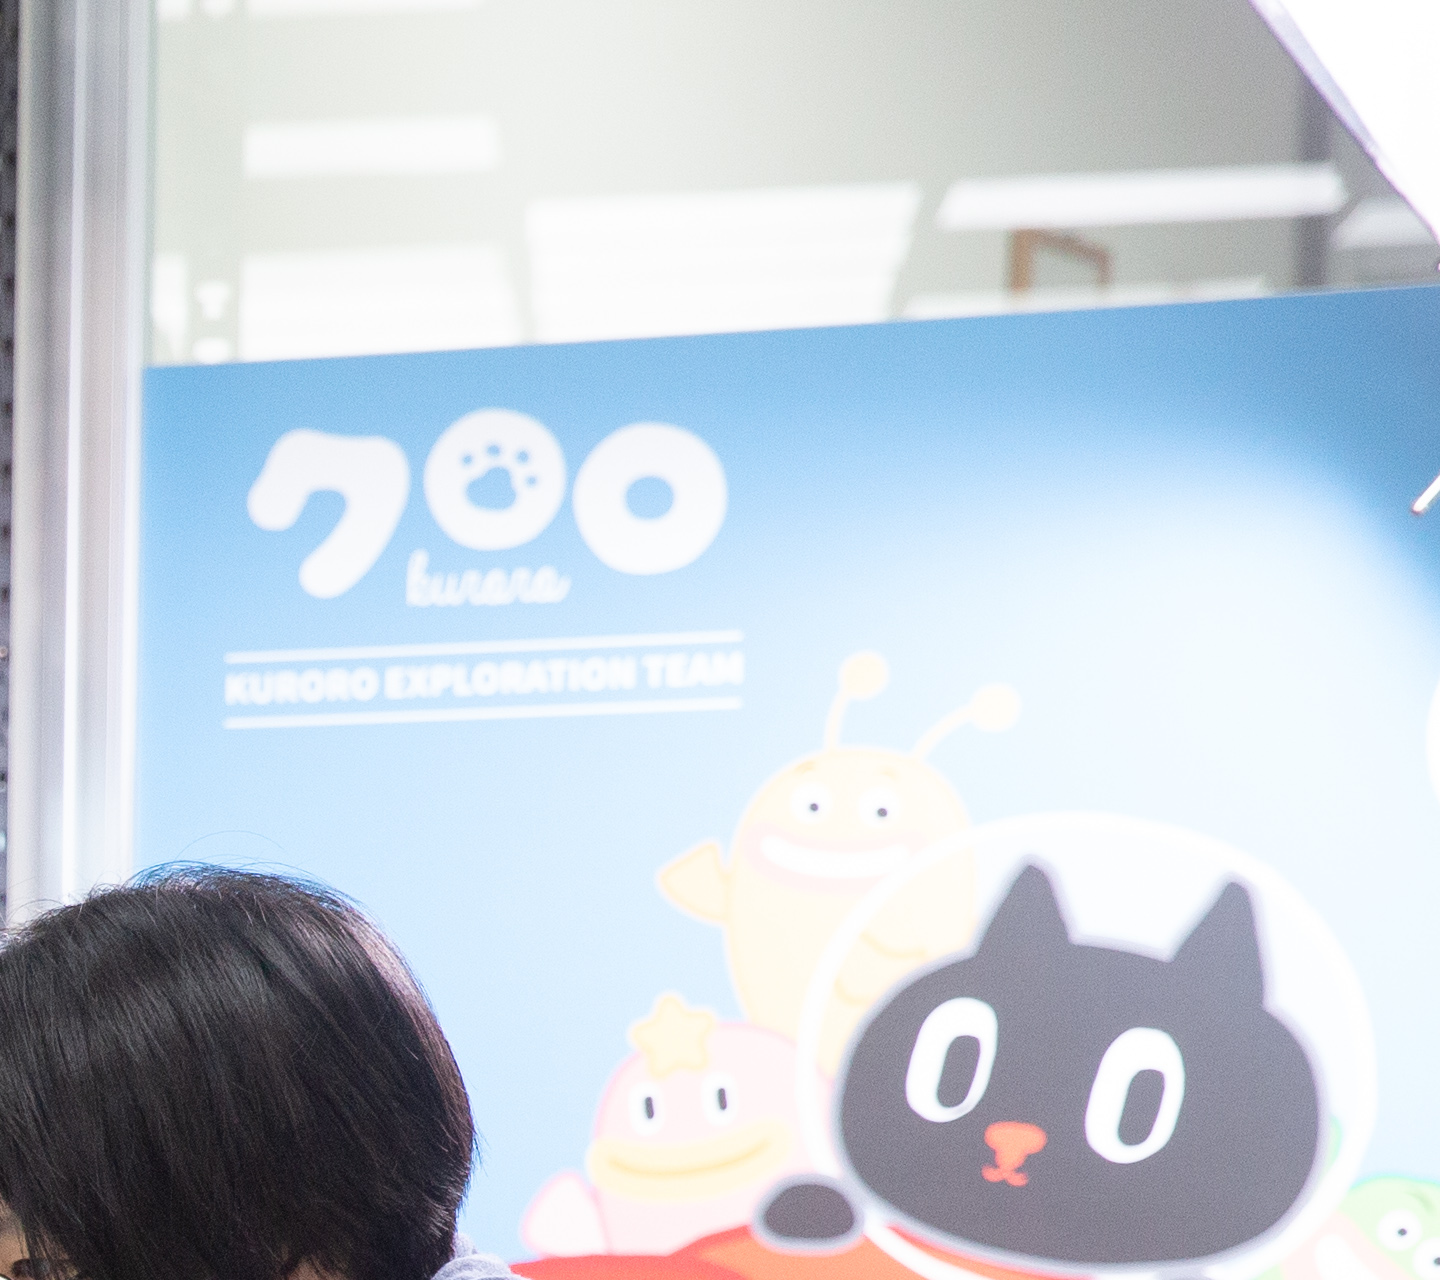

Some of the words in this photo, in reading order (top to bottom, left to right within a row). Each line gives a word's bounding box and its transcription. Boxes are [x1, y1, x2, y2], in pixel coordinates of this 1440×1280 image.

[225, 665, 379, 706] KURORO
[384, 655, 637, 700] EXPLORATION
[642, 651, 746, 689] TEAM
